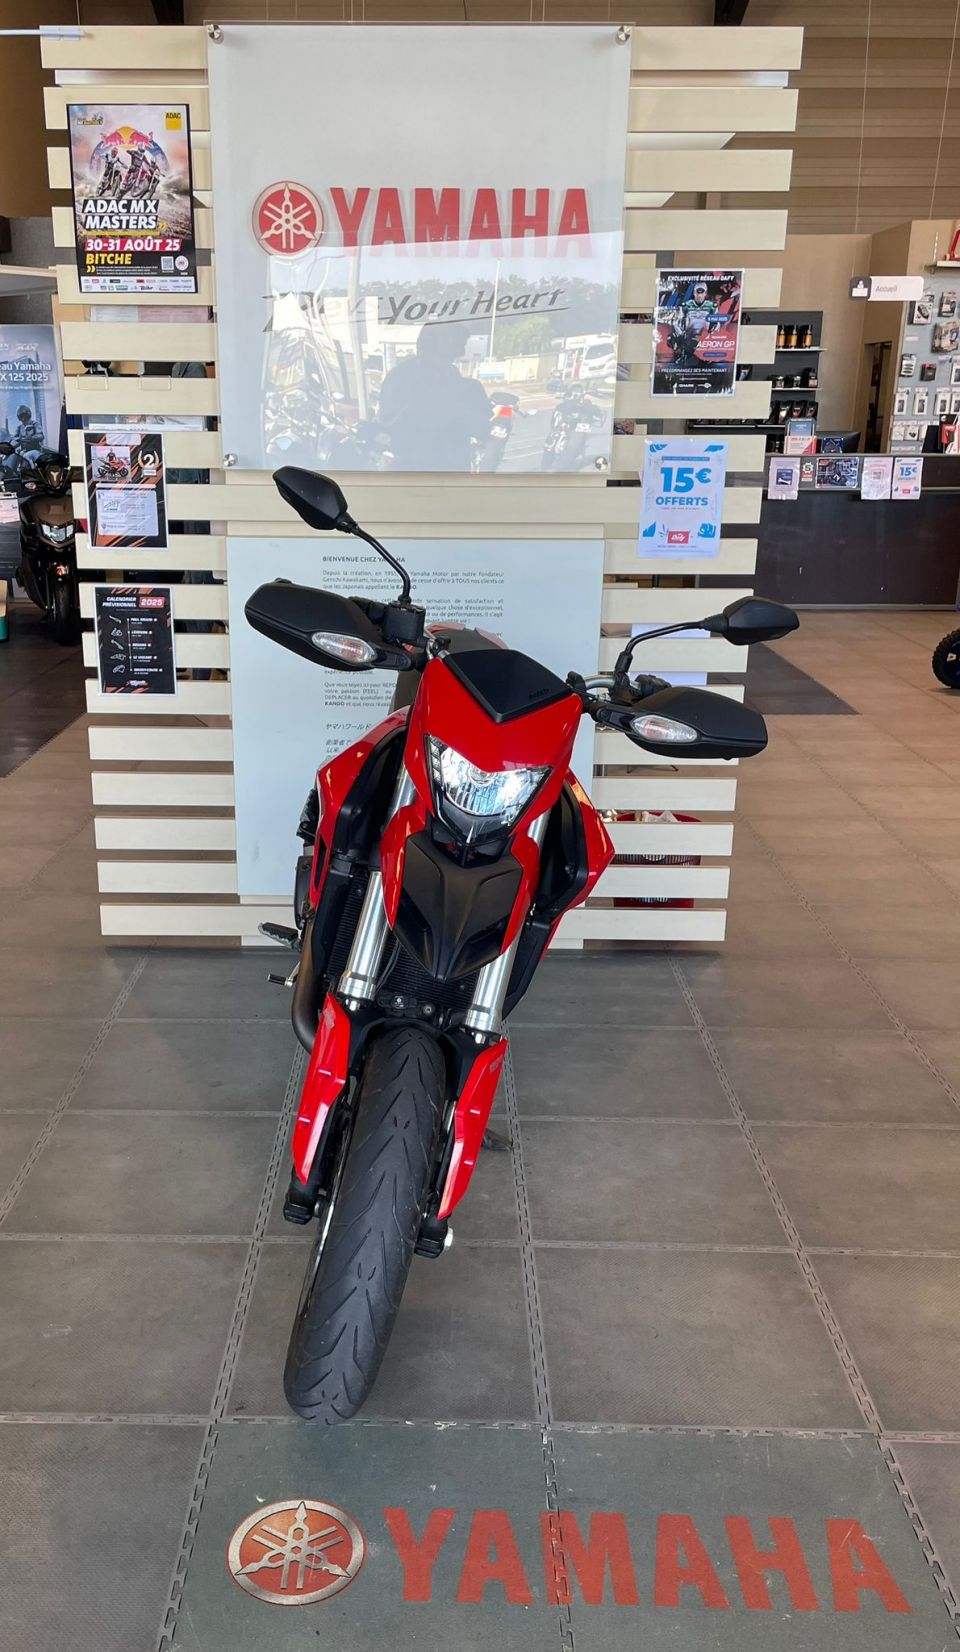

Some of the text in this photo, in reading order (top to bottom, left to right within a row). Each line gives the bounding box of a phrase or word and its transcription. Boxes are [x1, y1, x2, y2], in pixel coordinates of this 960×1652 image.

[84, 200, 158, 213] ADAC MX
[86, 216, 156, 229] MASTERS
[329, 187, 593, 257] YAMAHA
[86, 236, 180, 250] 30-31 AOÛT 25
[86, 254, 132, 264] BITCHE
[387, 294, 471, 325] Your
[471, 288, 567, 315] Heart
[14, 362, 51, 370] Yamaha
[9, 373, 24, 381] 125
[26, 373, 48, 381] 2025
[144, 454, 154, 468] 2
[900, 466, 917, 476] 15€
[660, 467, 712, 493] 15€
[656, 497, 708, 506] OFFERTS
[383, 1507, 912, 1614] YAMAHA
